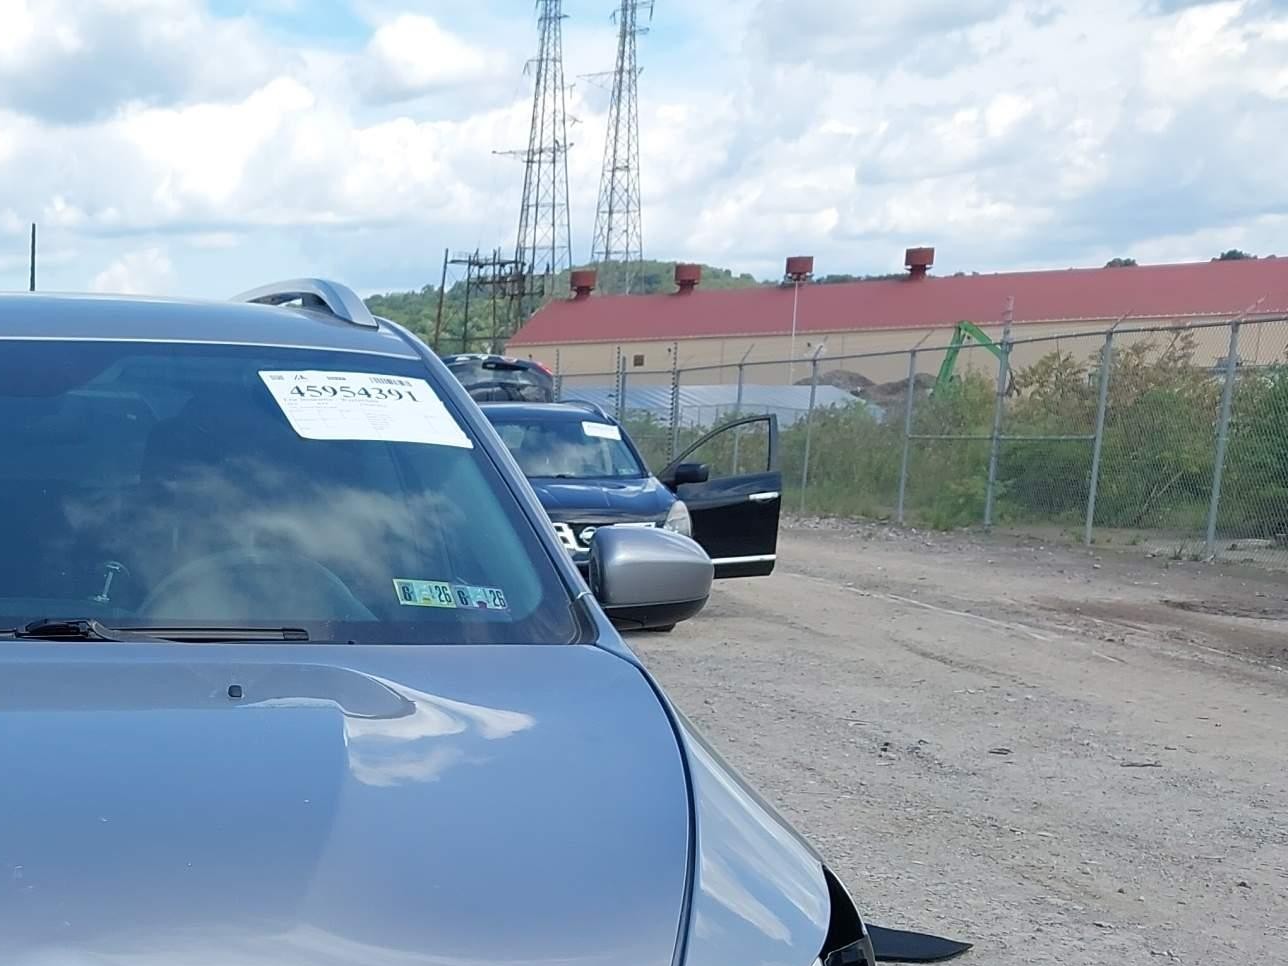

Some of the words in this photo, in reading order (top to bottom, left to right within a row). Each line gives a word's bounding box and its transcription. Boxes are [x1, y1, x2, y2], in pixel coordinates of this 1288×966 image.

[290, 385, 422, 402] 45954391
[435, 585, 452, 603] 26
[489, 590, 506, 607] 26
